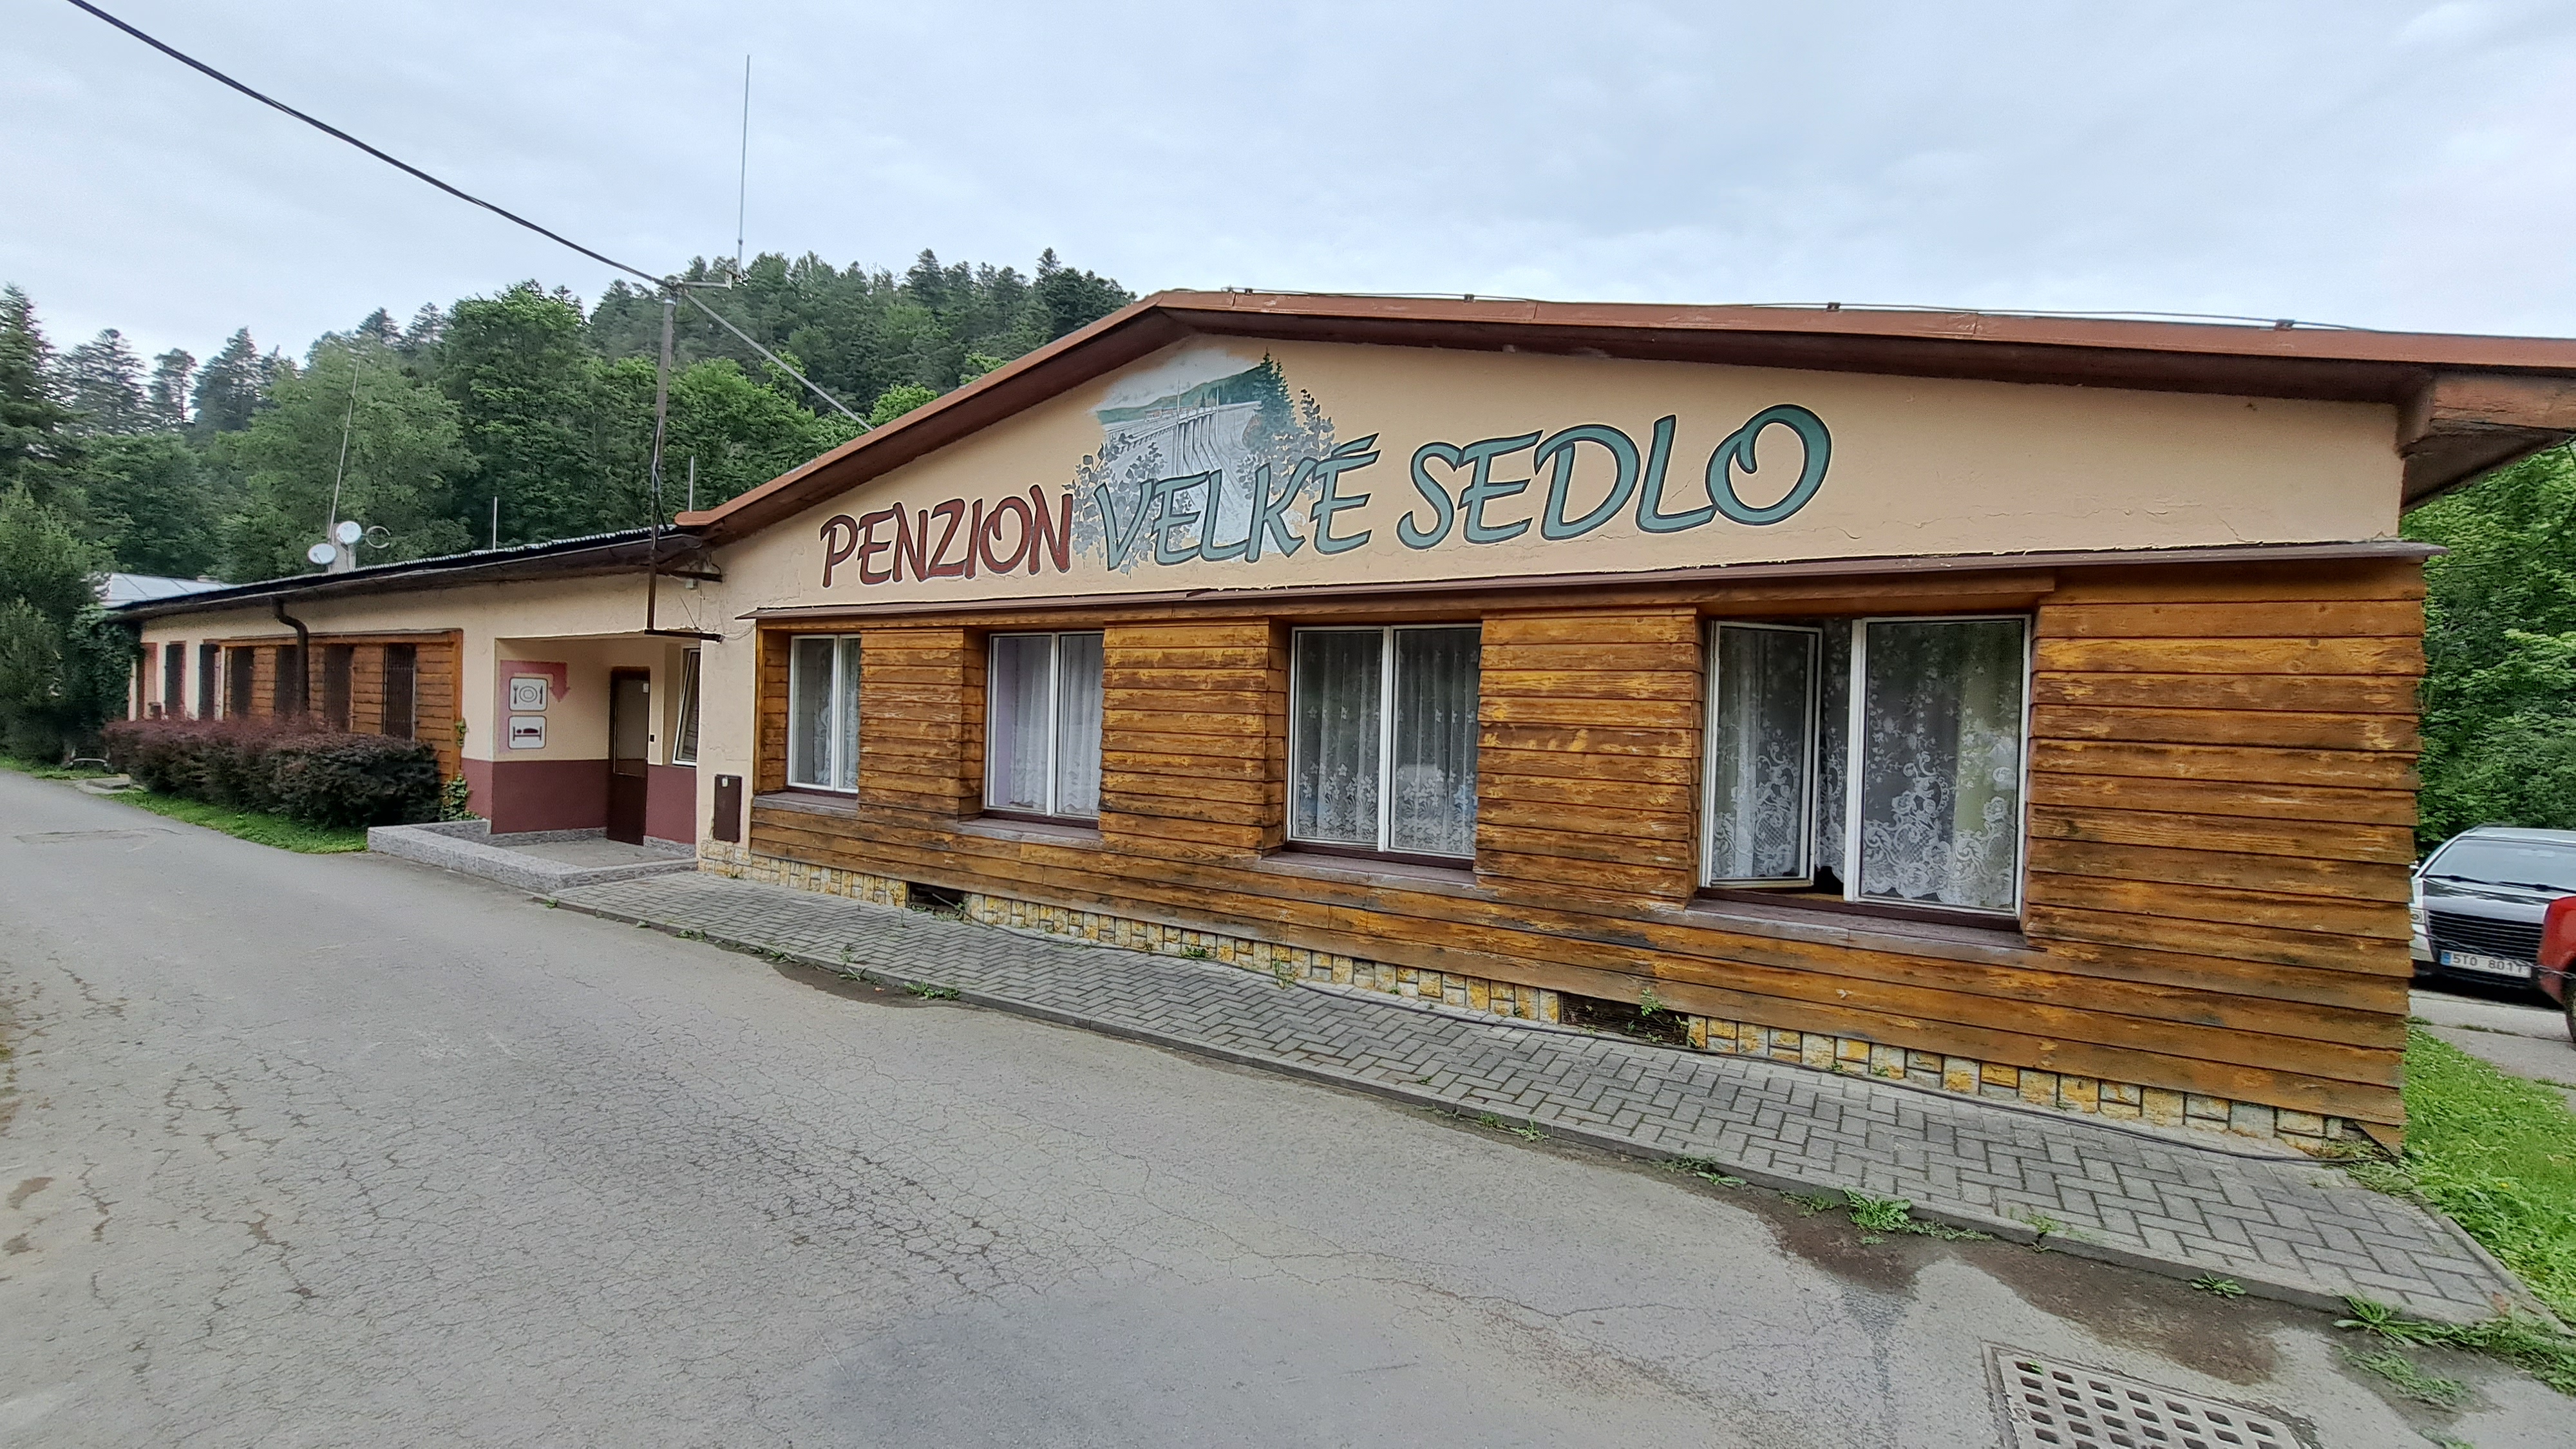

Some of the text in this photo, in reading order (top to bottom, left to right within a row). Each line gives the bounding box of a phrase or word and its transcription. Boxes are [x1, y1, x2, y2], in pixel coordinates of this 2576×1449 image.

[820, 404, 1832, 588] PENZION VELKÉ SEDLO
